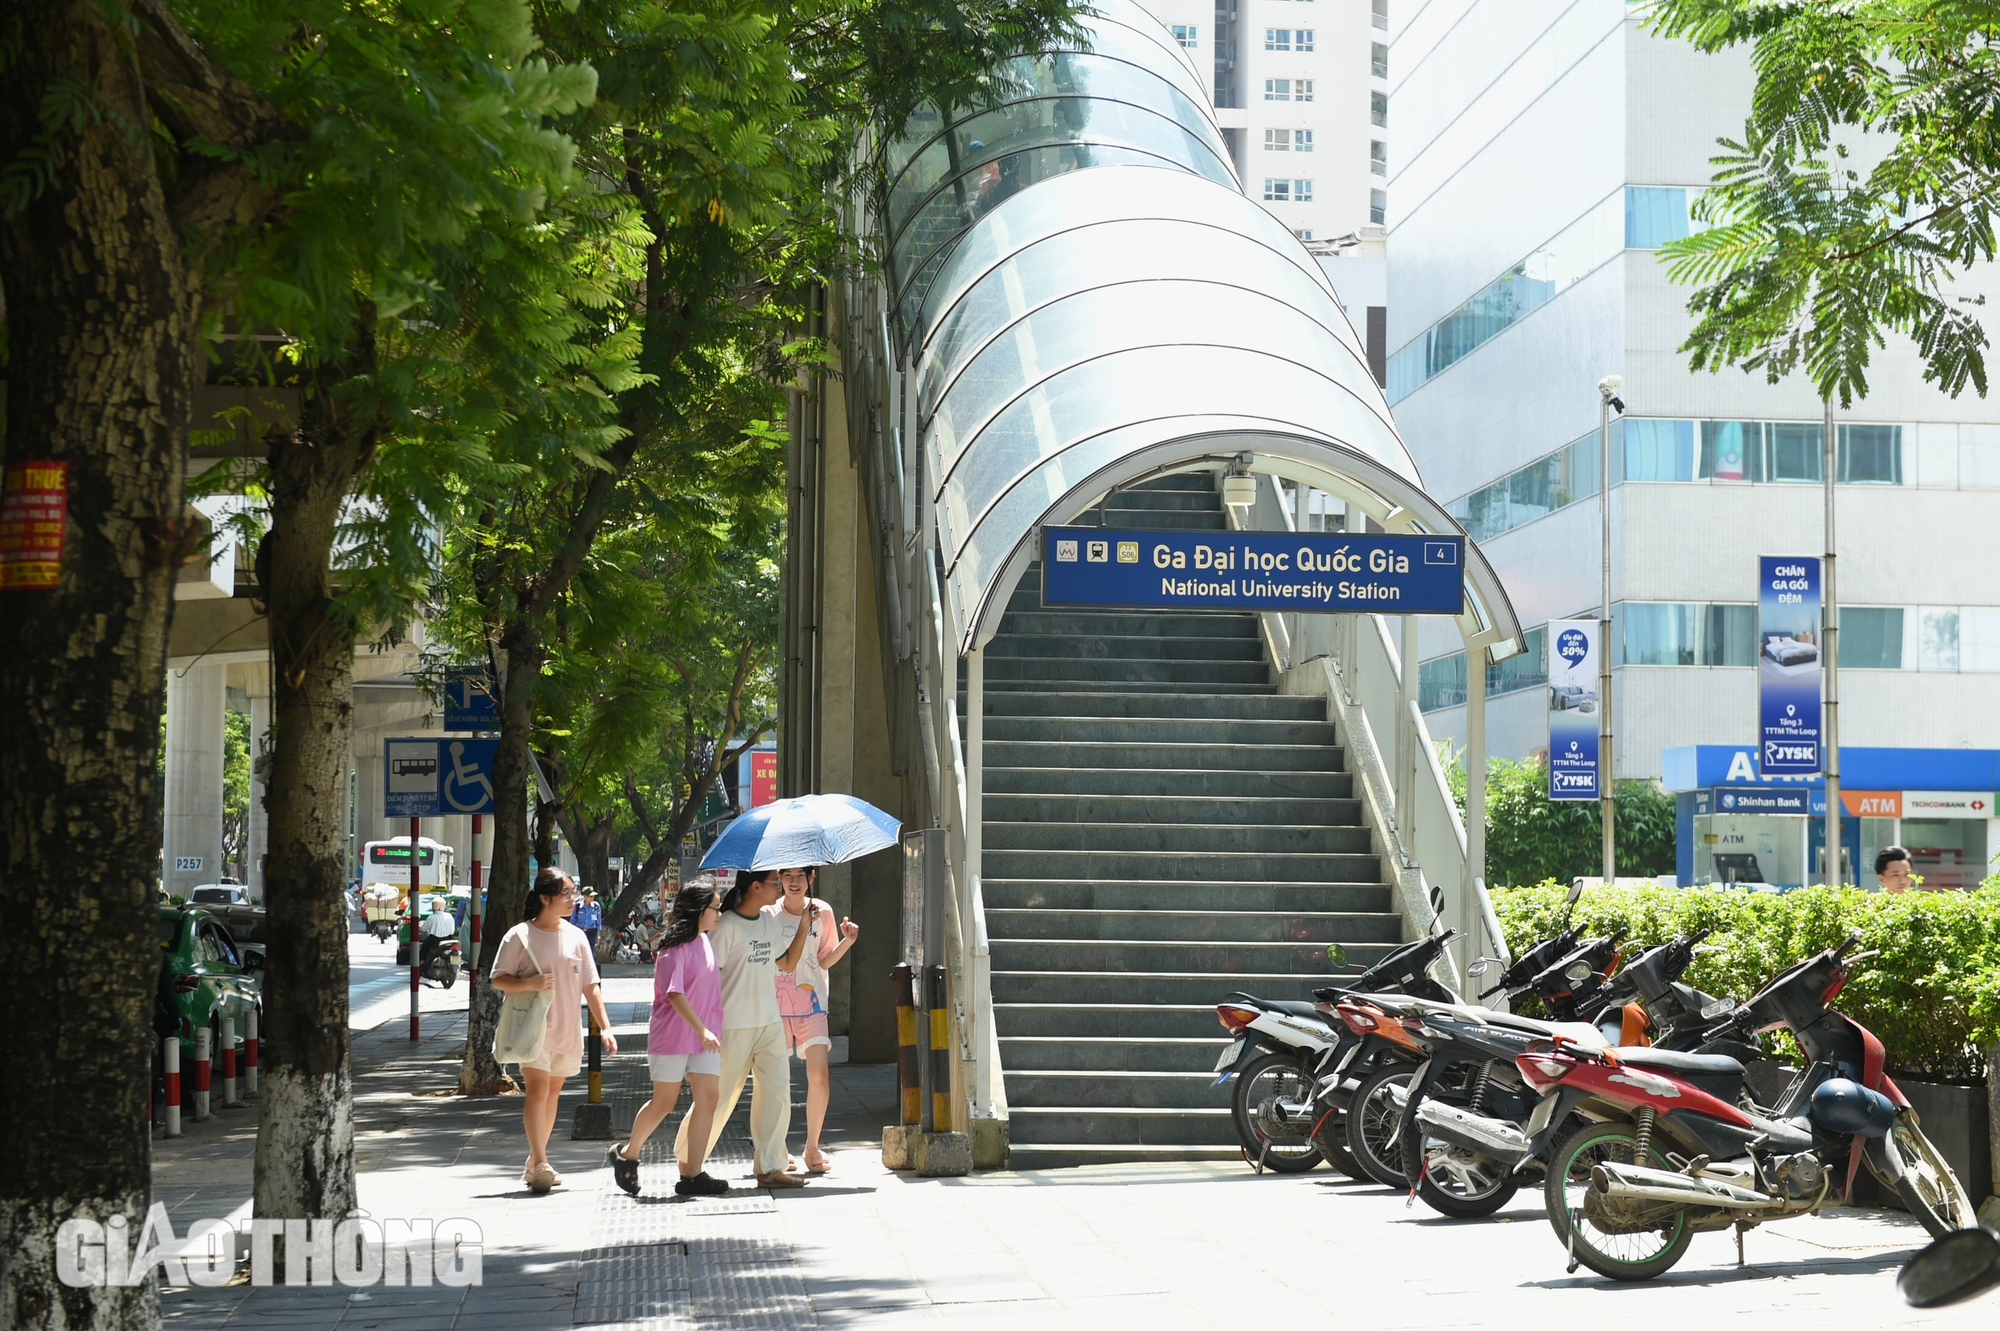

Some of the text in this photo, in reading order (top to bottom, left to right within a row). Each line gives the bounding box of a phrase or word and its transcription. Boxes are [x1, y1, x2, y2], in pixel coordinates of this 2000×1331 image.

[1437, 547, 1445, 559] 4
[1153, 544, 1409, 577] Ga Đại học Quốc Gia
[1775, 565, 1805, 577] CHĂN
[1772, 577, 1809, 591] GA GỐI
[1161, 578, 1401, 603] National University Station
[1777, 592, 1802, 607] ĐỆM
[1562, 647, 1585, 656] 50%
[1779, 717, 1803, 727] Tầng 3
[1764, 727, 1818, 737] TTTM The Loop
[1776, 746, 1814, 760] JYSK
[1553, 759, 1596, 768] TTTM The Loop
[756, 769, 767, 778] XE
[1562, 775, 1593, 787] JYSK
[419, 794, 428, 802] XE
[1737, 796, 1801, 808] Shinhan Bank
[1911, 800, 1967, 808] TECHCOMBANK
[396, 804, 431, 812] BUS STOP
[1859, 798, 1896, 813] ATM
[1722, 835, 1744, 844] ATM
[176, 858, 202, 870] P257
